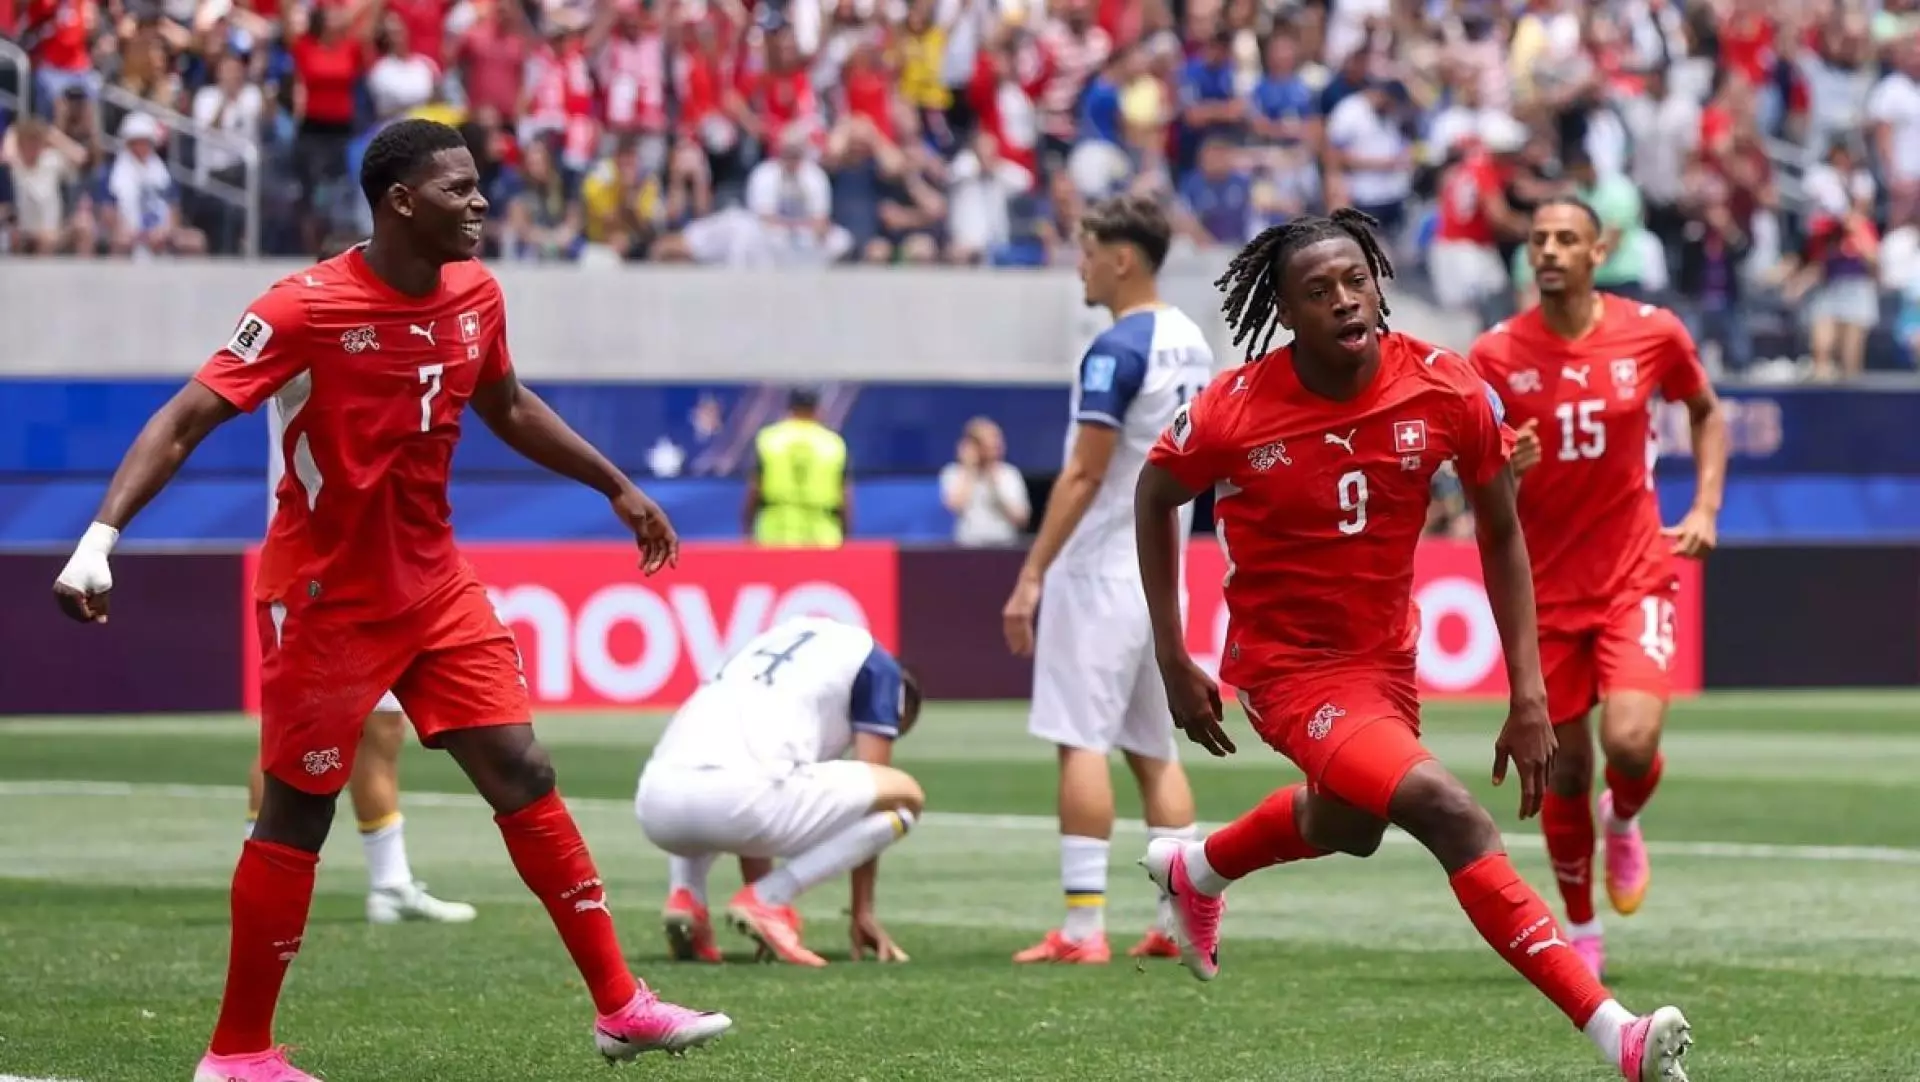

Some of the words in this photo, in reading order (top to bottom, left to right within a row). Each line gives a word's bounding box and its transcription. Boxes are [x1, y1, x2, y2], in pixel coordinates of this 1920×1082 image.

[418, 363, 444, 433] 7
[1556, 398, 1607, 461] 15
[1337, 469, 1368, 536] 9
